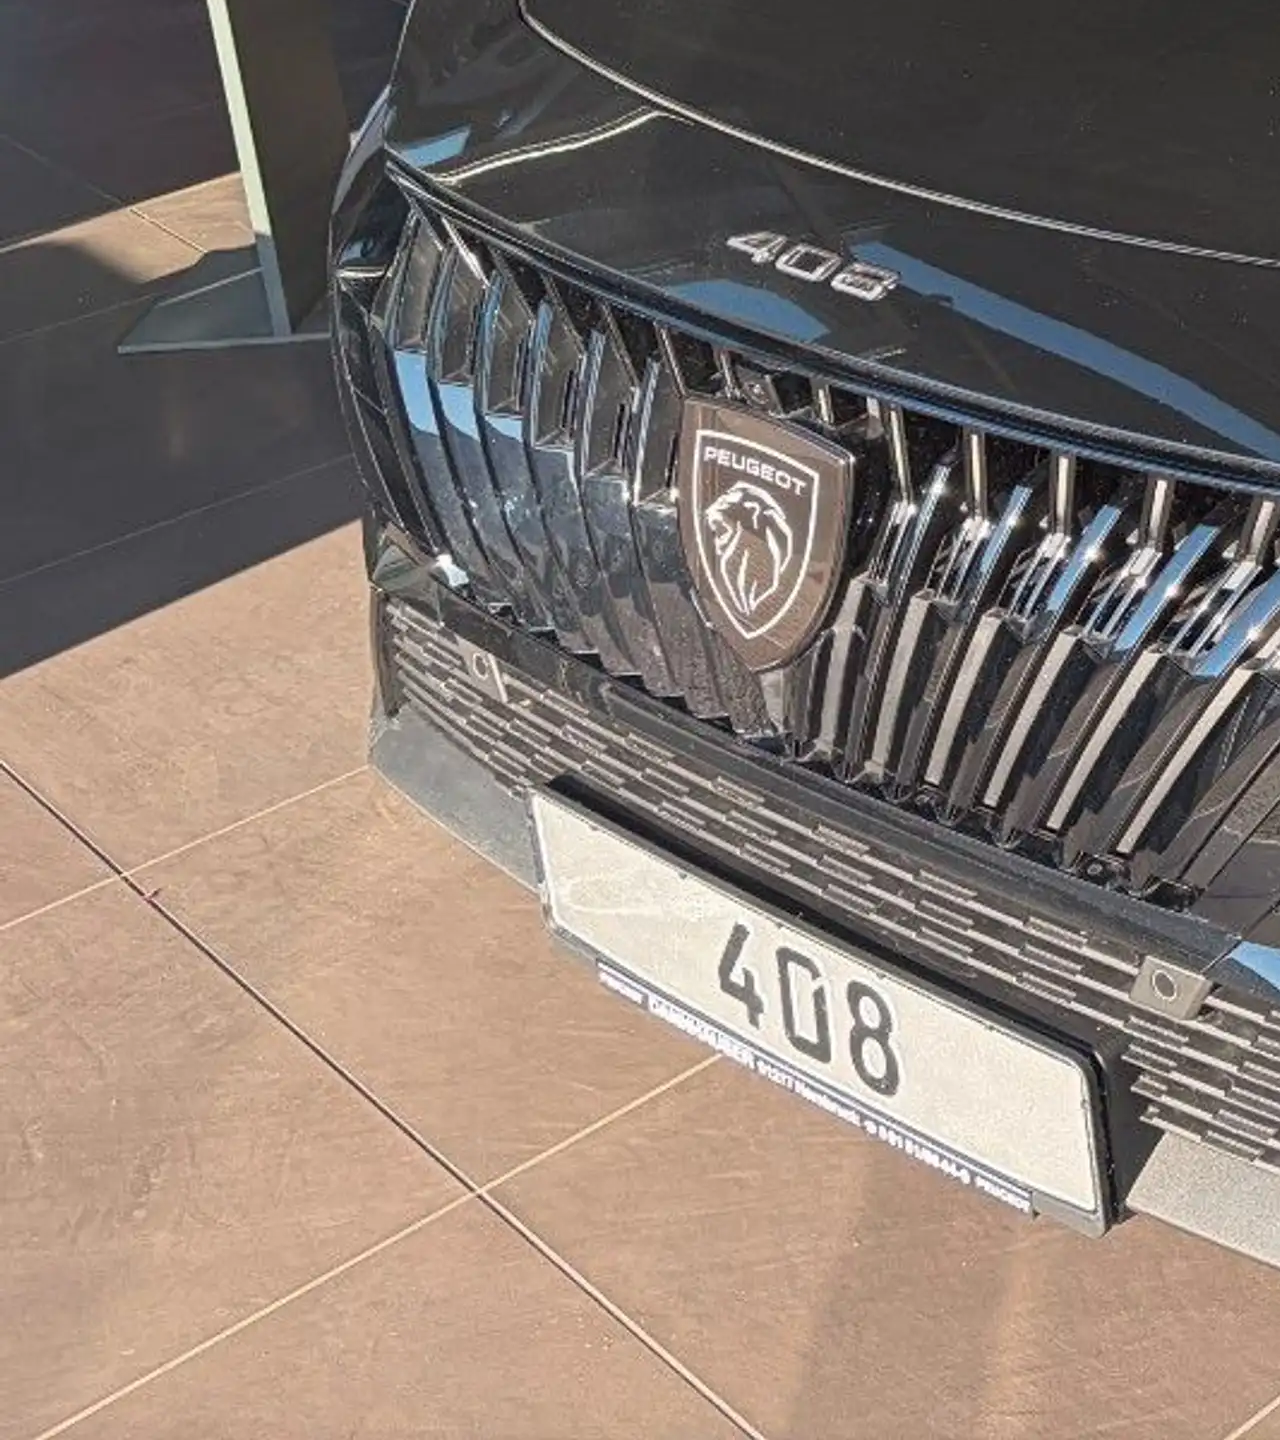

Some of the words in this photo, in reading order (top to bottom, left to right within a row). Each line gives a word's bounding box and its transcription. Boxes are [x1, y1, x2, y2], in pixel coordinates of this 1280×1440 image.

[727, 231, 900, 302] 408
[703, 445, 807, 497] PEUGEOT
[718, 921, 902, 1097] 408
